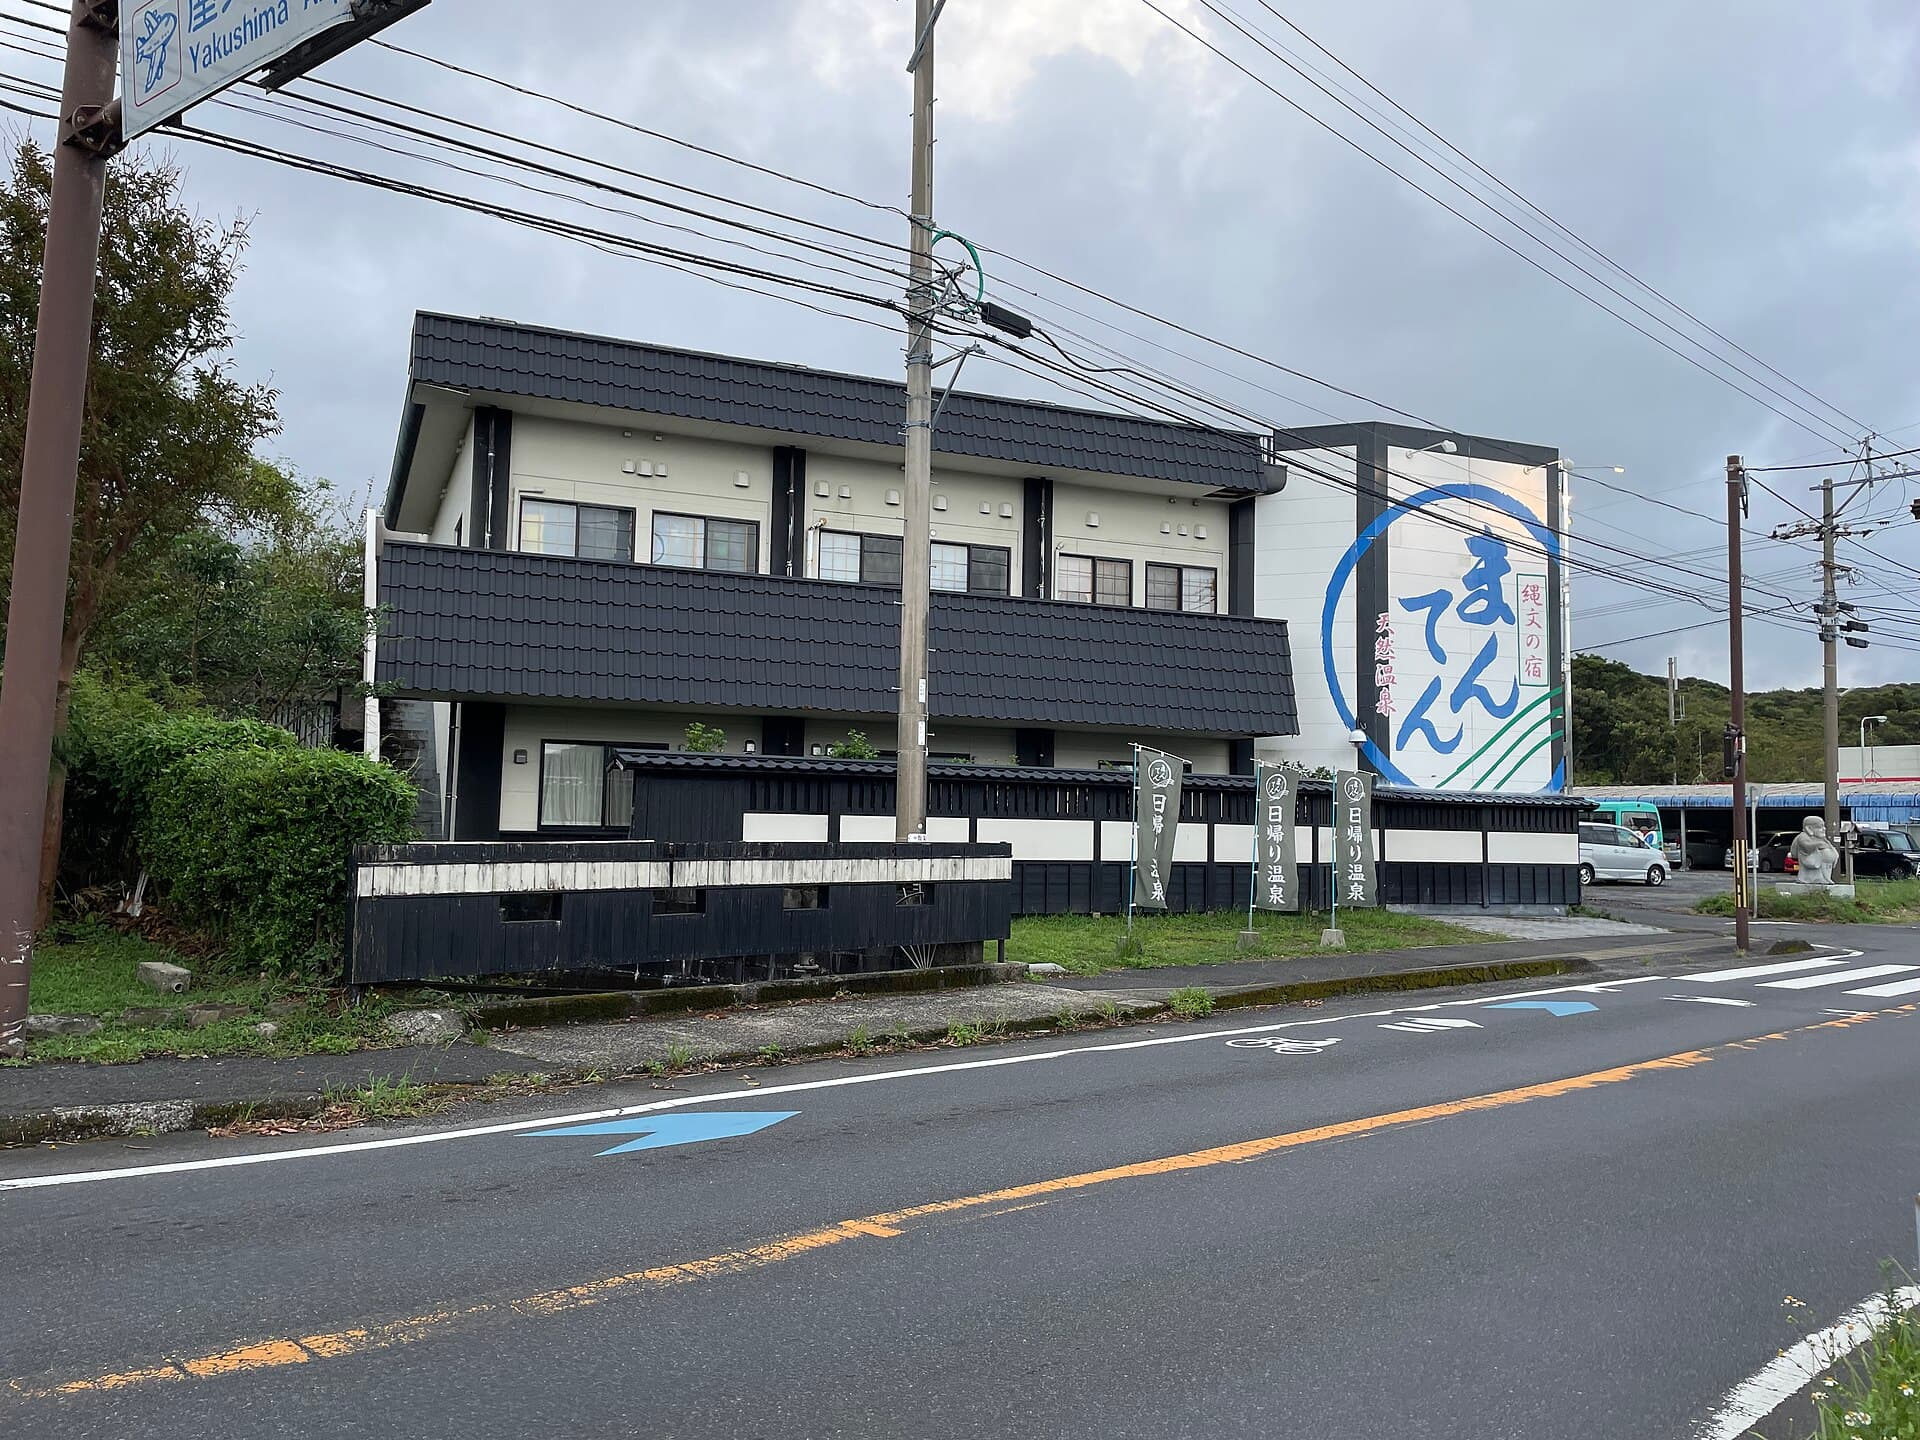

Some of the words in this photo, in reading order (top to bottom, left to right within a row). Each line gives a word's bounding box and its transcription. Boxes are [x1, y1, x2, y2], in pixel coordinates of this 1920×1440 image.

[189, 0, 289, 73] Yakushima
[1374, 612, 1397, 717] 天然温泉
[1521, 583, 1544, 679] 縄文の宿
[1266, 805, 1286, 905] 日帰り温泉
[1346, 807, 1366, 901] 日帰り温泉
